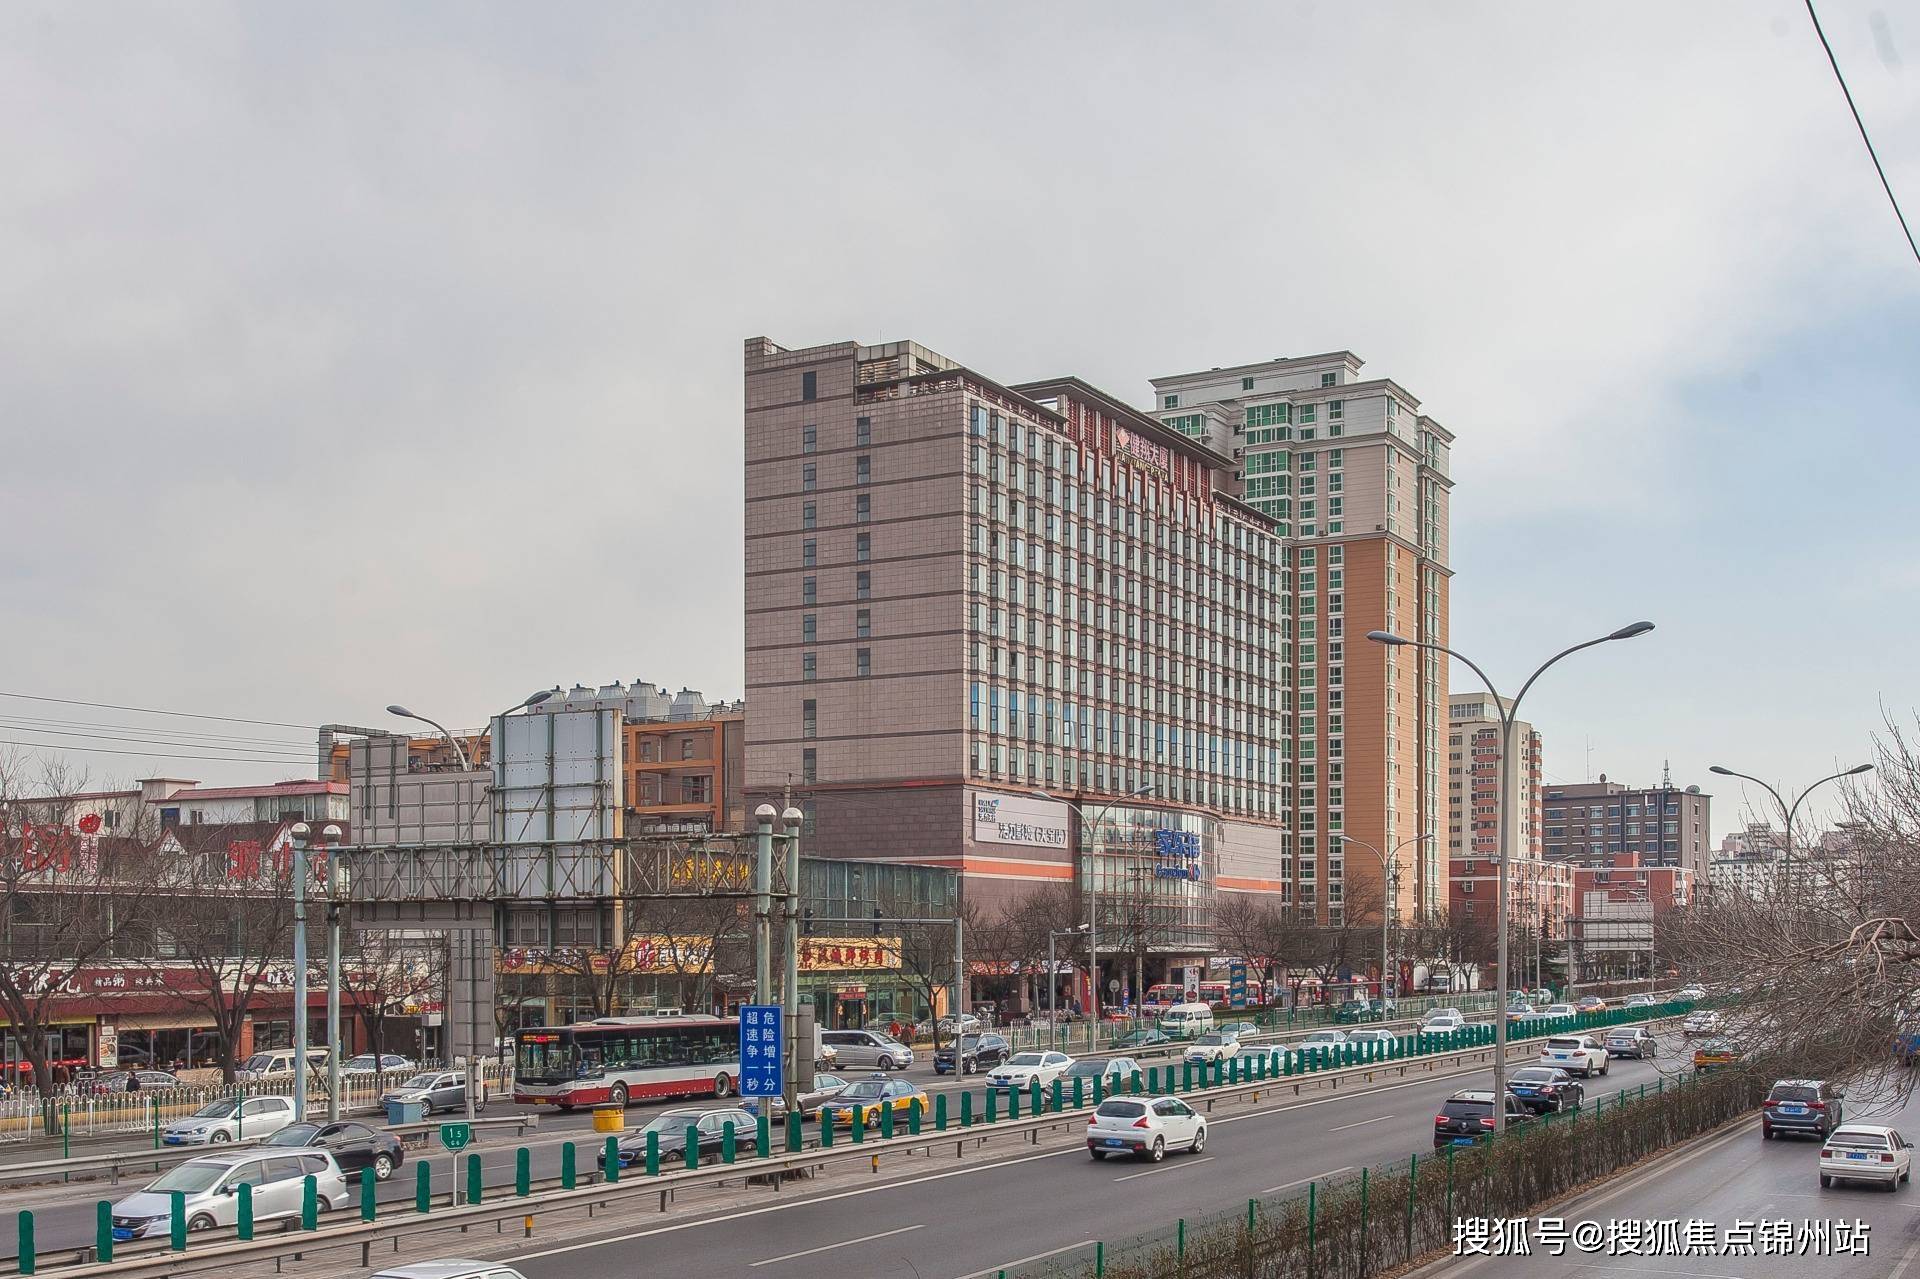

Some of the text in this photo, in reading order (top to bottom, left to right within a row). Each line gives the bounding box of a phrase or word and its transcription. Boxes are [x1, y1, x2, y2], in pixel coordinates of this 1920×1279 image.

[746, 1011, 759, 1091] 超速争一秒
[762, 1011, 776, 1091] 危险增十分
